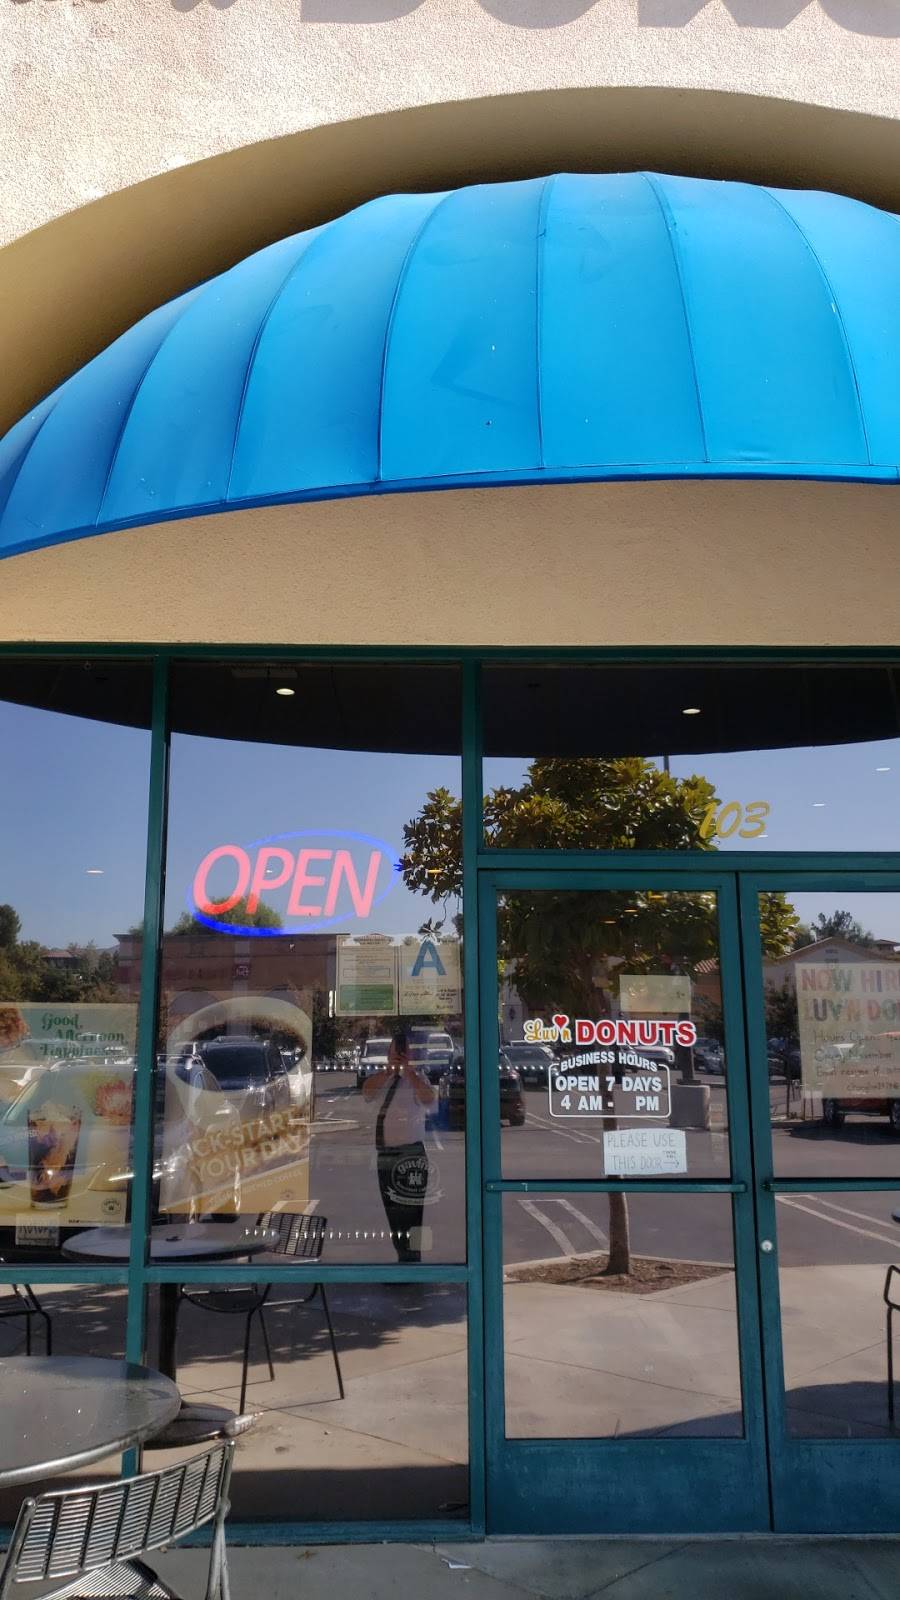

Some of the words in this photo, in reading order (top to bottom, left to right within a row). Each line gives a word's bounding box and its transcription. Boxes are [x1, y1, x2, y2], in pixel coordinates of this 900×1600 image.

[699, 801, 770, 839] 103
[193, 845, 382, 918] OPEN
[411, 935, 447, 977] A
[801, 968, 853, 992] NOW
[860, 969, 900, 993] HIR
[866, 998, 900, 1022] DO
[575, 1019, 697, 1046] DONUTS
[560, 1051, 615, 1072] BUSINESS
[618, 1052, 658, 1073] HOURS
[555, 1076, 600, 1092] OPEN
[605, 1076, 615, 1092] 7
[621, 1076, 662, 1092] DAYS
[560, 1094, 571, 1111] 4
[578, 1095, 602, 1111] AM
[635, 1095, 660, 1111] PM
[607, 1132, 648, 1148] PLEASE
[653, 1132, 677, 1147] USE
[190, 1147, 258, 1182] YOUR
[260, 1130, 309, 1162] DAY
[607, 1154, 636, 1170] THIS
[640, 1155, 663, 1170] DOOR
